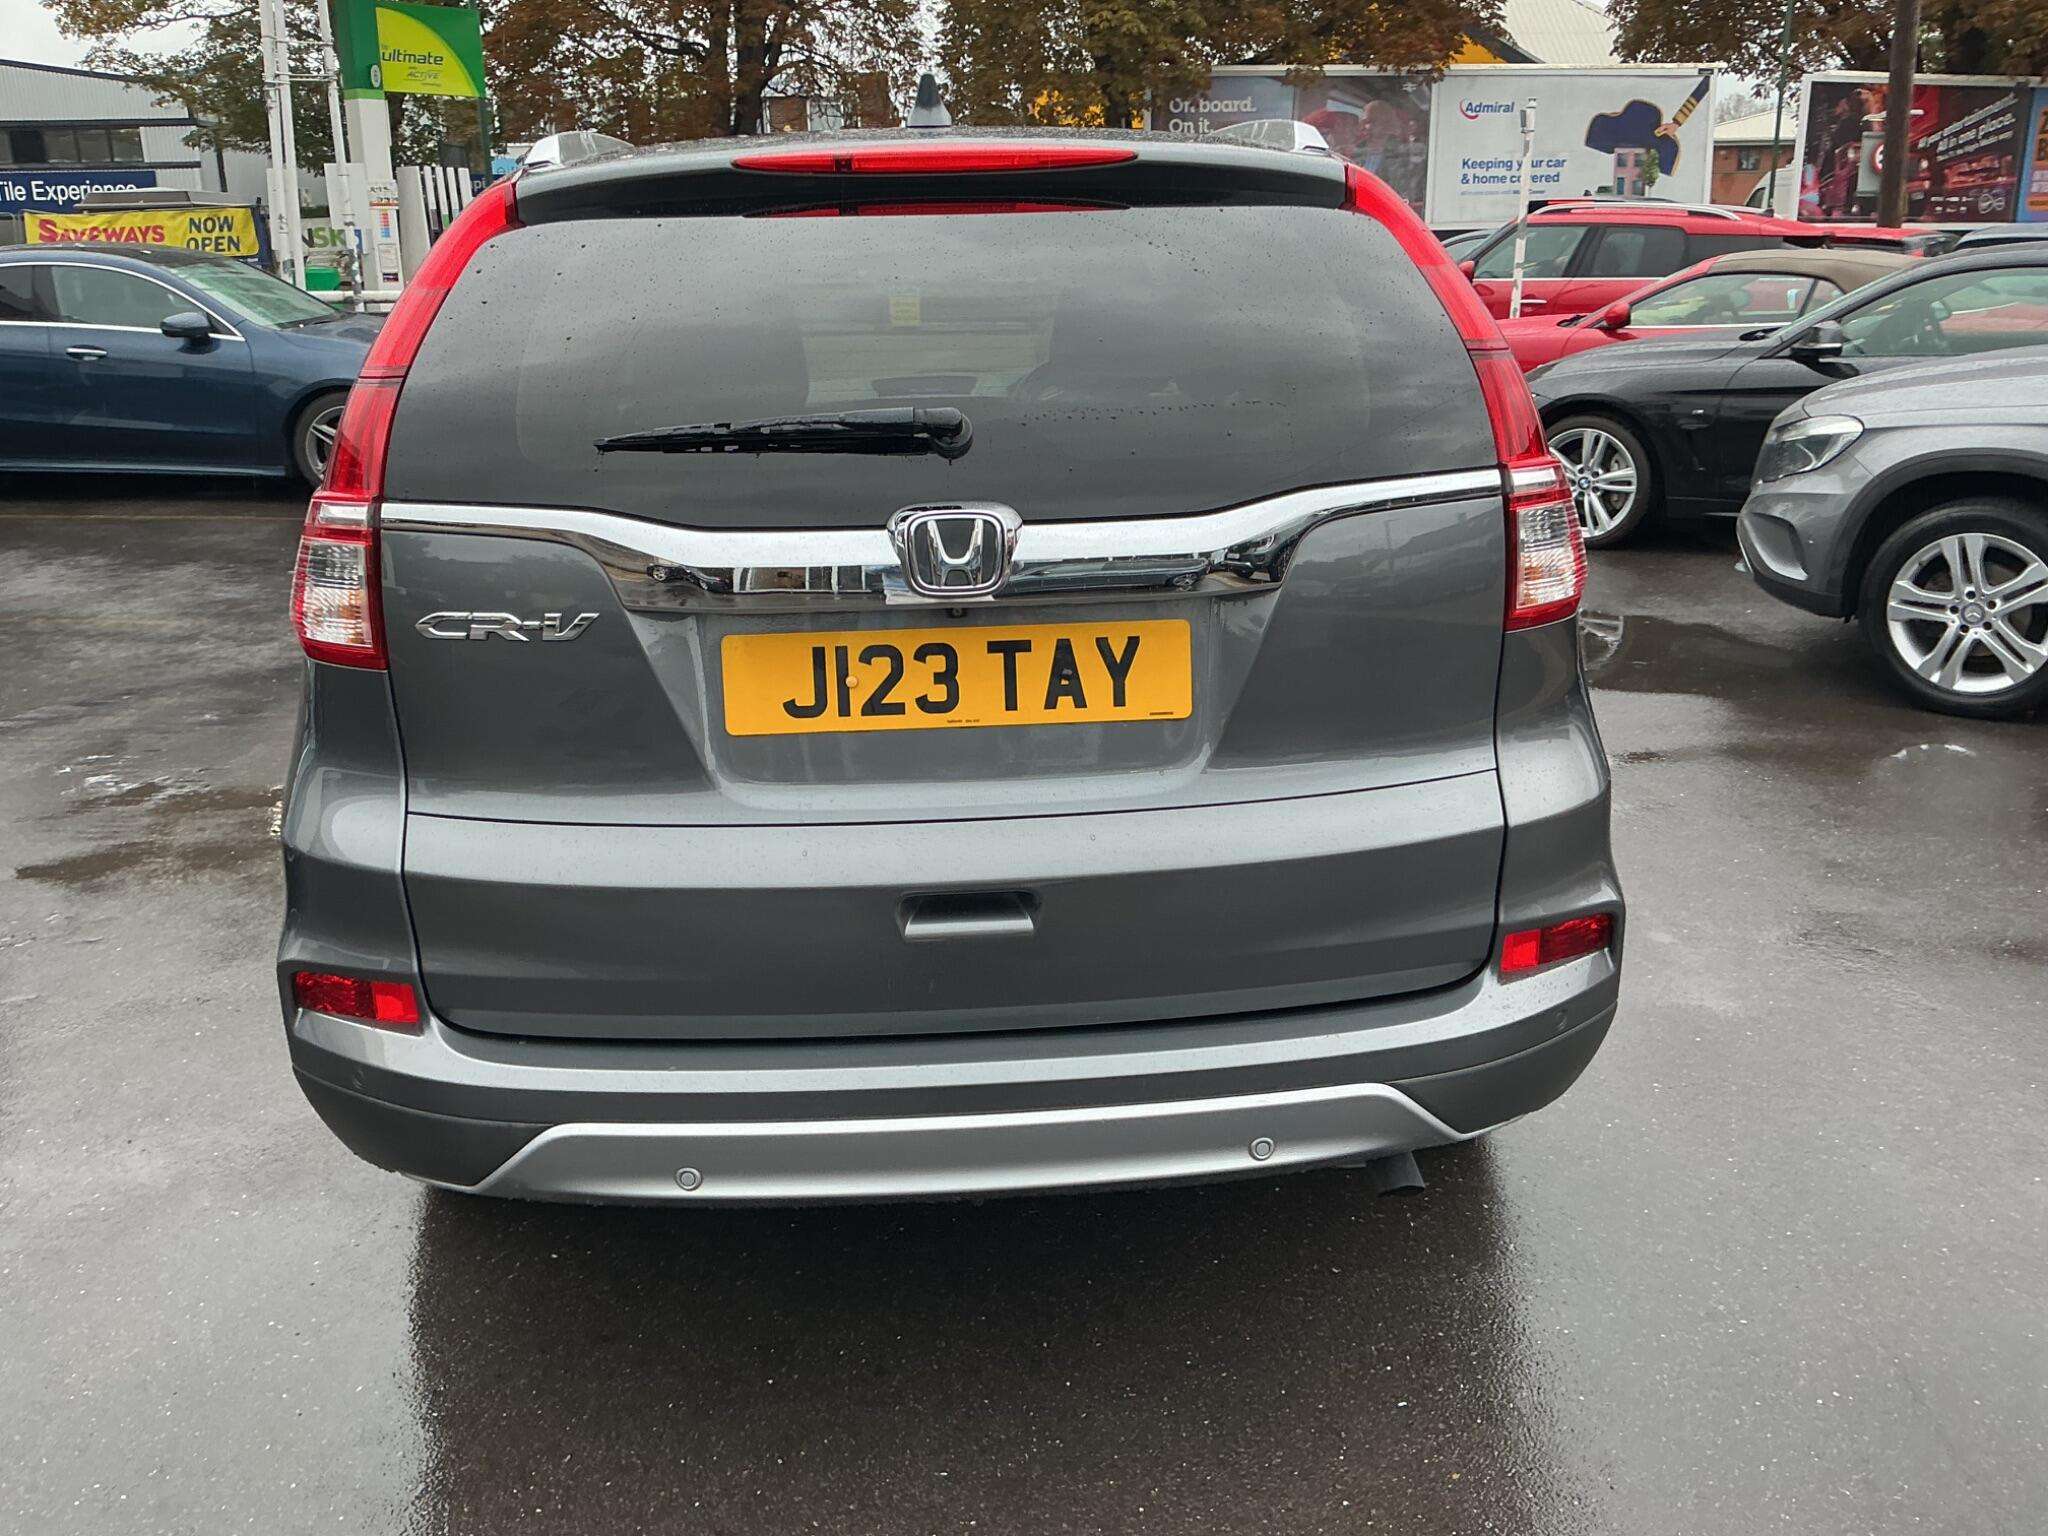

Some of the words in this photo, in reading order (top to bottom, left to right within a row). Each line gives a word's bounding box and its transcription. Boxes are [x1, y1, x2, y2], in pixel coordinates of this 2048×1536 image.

[381, 49, 444, 66] ultimate
[1199, 95, 1258, 113] board.
[1466, 101, 1516, 114] Admiral
[1169, 118, 1195, 134] On
[1461, 158, 1514, 172] Keeping
[1516, 159, 1546, 172] yur
[1546, 159, 1566, 168] car
[1461, 173, 1470, 185] &
[1472, 173, 1508, 184] home
[1509, 172, 1560, 184] cered
[188, 215, 235, 234] NOW
[186, 235, 241, 252] OPEN
[415, 611, 600, 642] CR-V
[986, 635, 1141, 712] TAY
